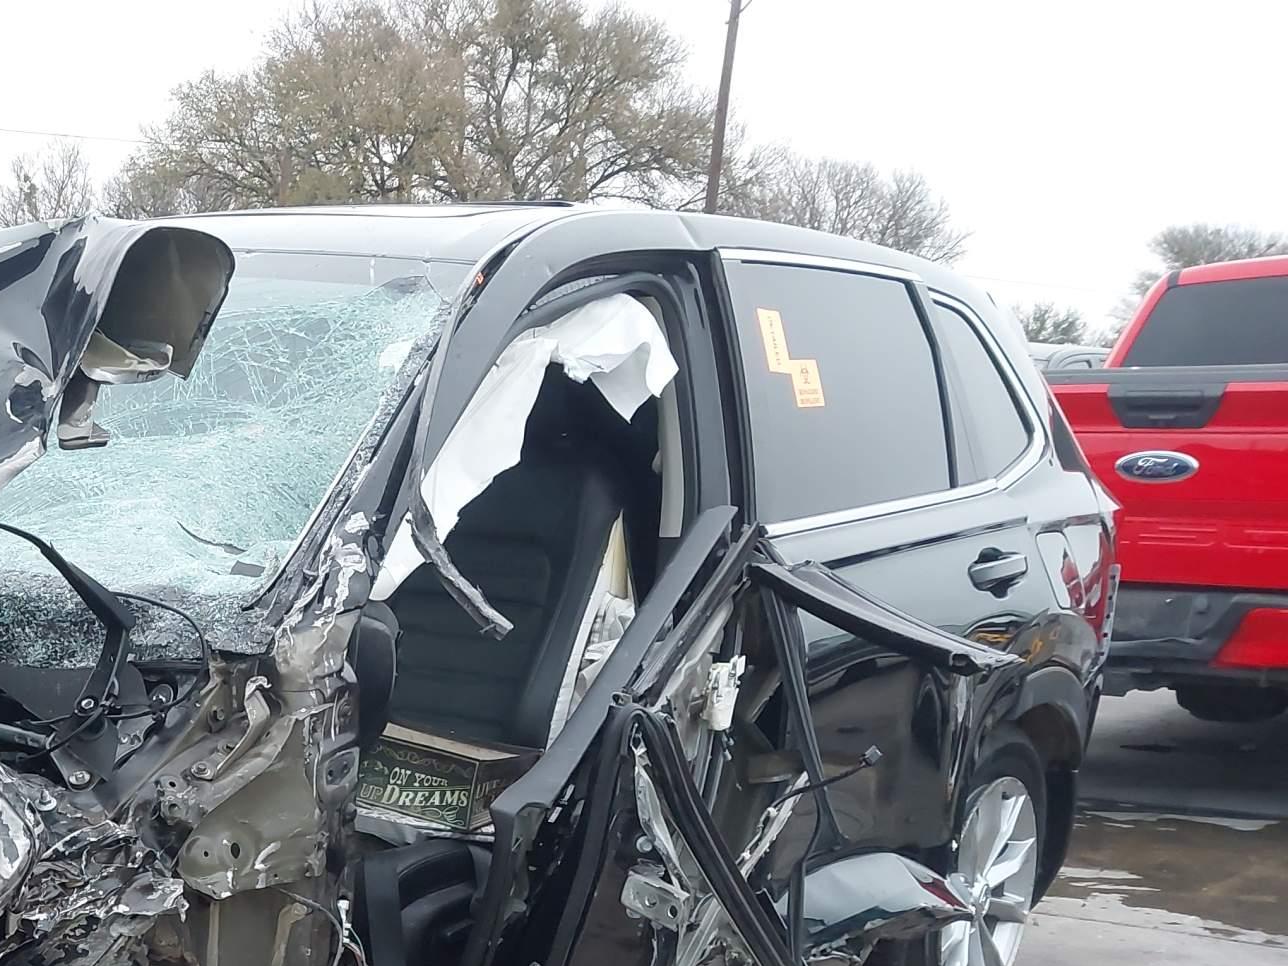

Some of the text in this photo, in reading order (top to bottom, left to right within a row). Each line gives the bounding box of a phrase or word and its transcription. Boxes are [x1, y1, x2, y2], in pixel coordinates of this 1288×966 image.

[389, 767, 448, 787] ON YOUR
[360, 783, 384, 800] UP
[382, 784, 469, 807] DREAMS
